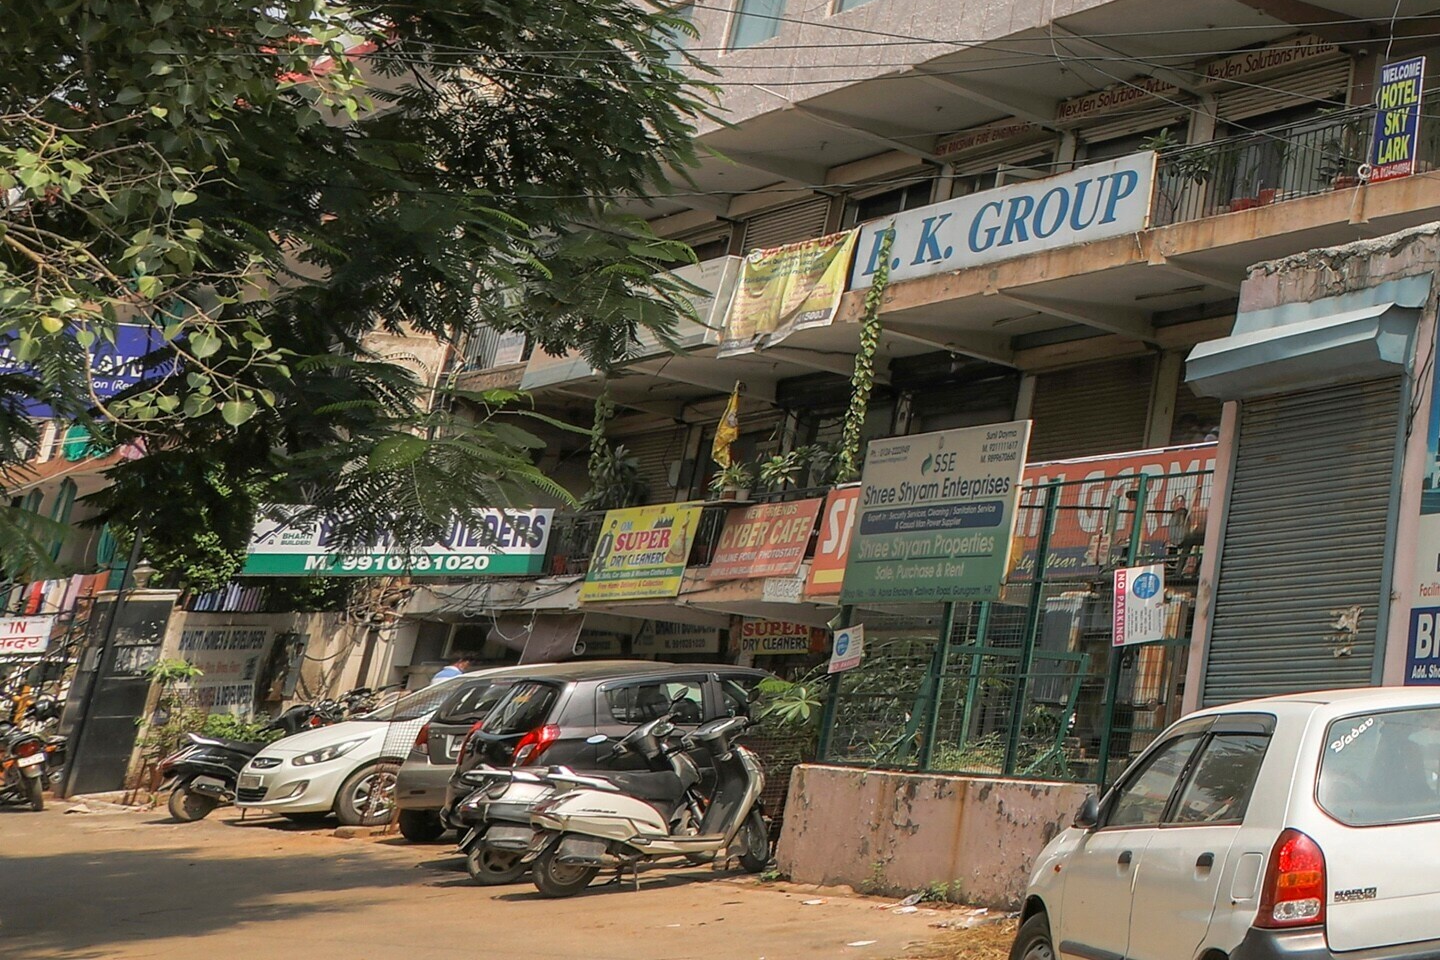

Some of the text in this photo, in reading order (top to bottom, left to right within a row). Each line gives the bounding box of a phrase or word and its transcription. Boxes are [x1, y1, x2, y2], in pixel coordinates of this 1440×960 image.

[1244, 48, 1293, 73] Solutions
[1383, 61, 1421, 83] WELCOME
[1098, 85, 1145, 108] Solutions
[1381, 79, 1418, 109] HOTEL
[1384, 107, 1410, 137] SKY
[1378, 135, 1410, 165] LARK
[910, 212, 953, 266] K.
[968, 170, 1139, 254] GROUP
[934, 452, 957, 473] SSE
[864, 474, 1010, 505] Shree Shyam Enterprises
[745, 504, 799, 520] NEW FRIENDS
[614, 529, 672, 552] SUPER
[720, 522, 768, 549] CYBER
[769, 517, 811, 545] CAFE
[858, 533, 994, 560] Shree Shyam Properties
[343, 555, 489, 571] 9910281020
[610, 552, 667, 567] DRY CLEANERS
[896, 563, 934, 579] Purchase
[945, 562, 964, 578] Rent
[1116, 573, 1125, 642] NO PARKING
[743, 621, 808, 637] SUPER
[743, 637, 808, 650] DRY CLEANERS
[1330, 717, 1374, 752] Yadav
